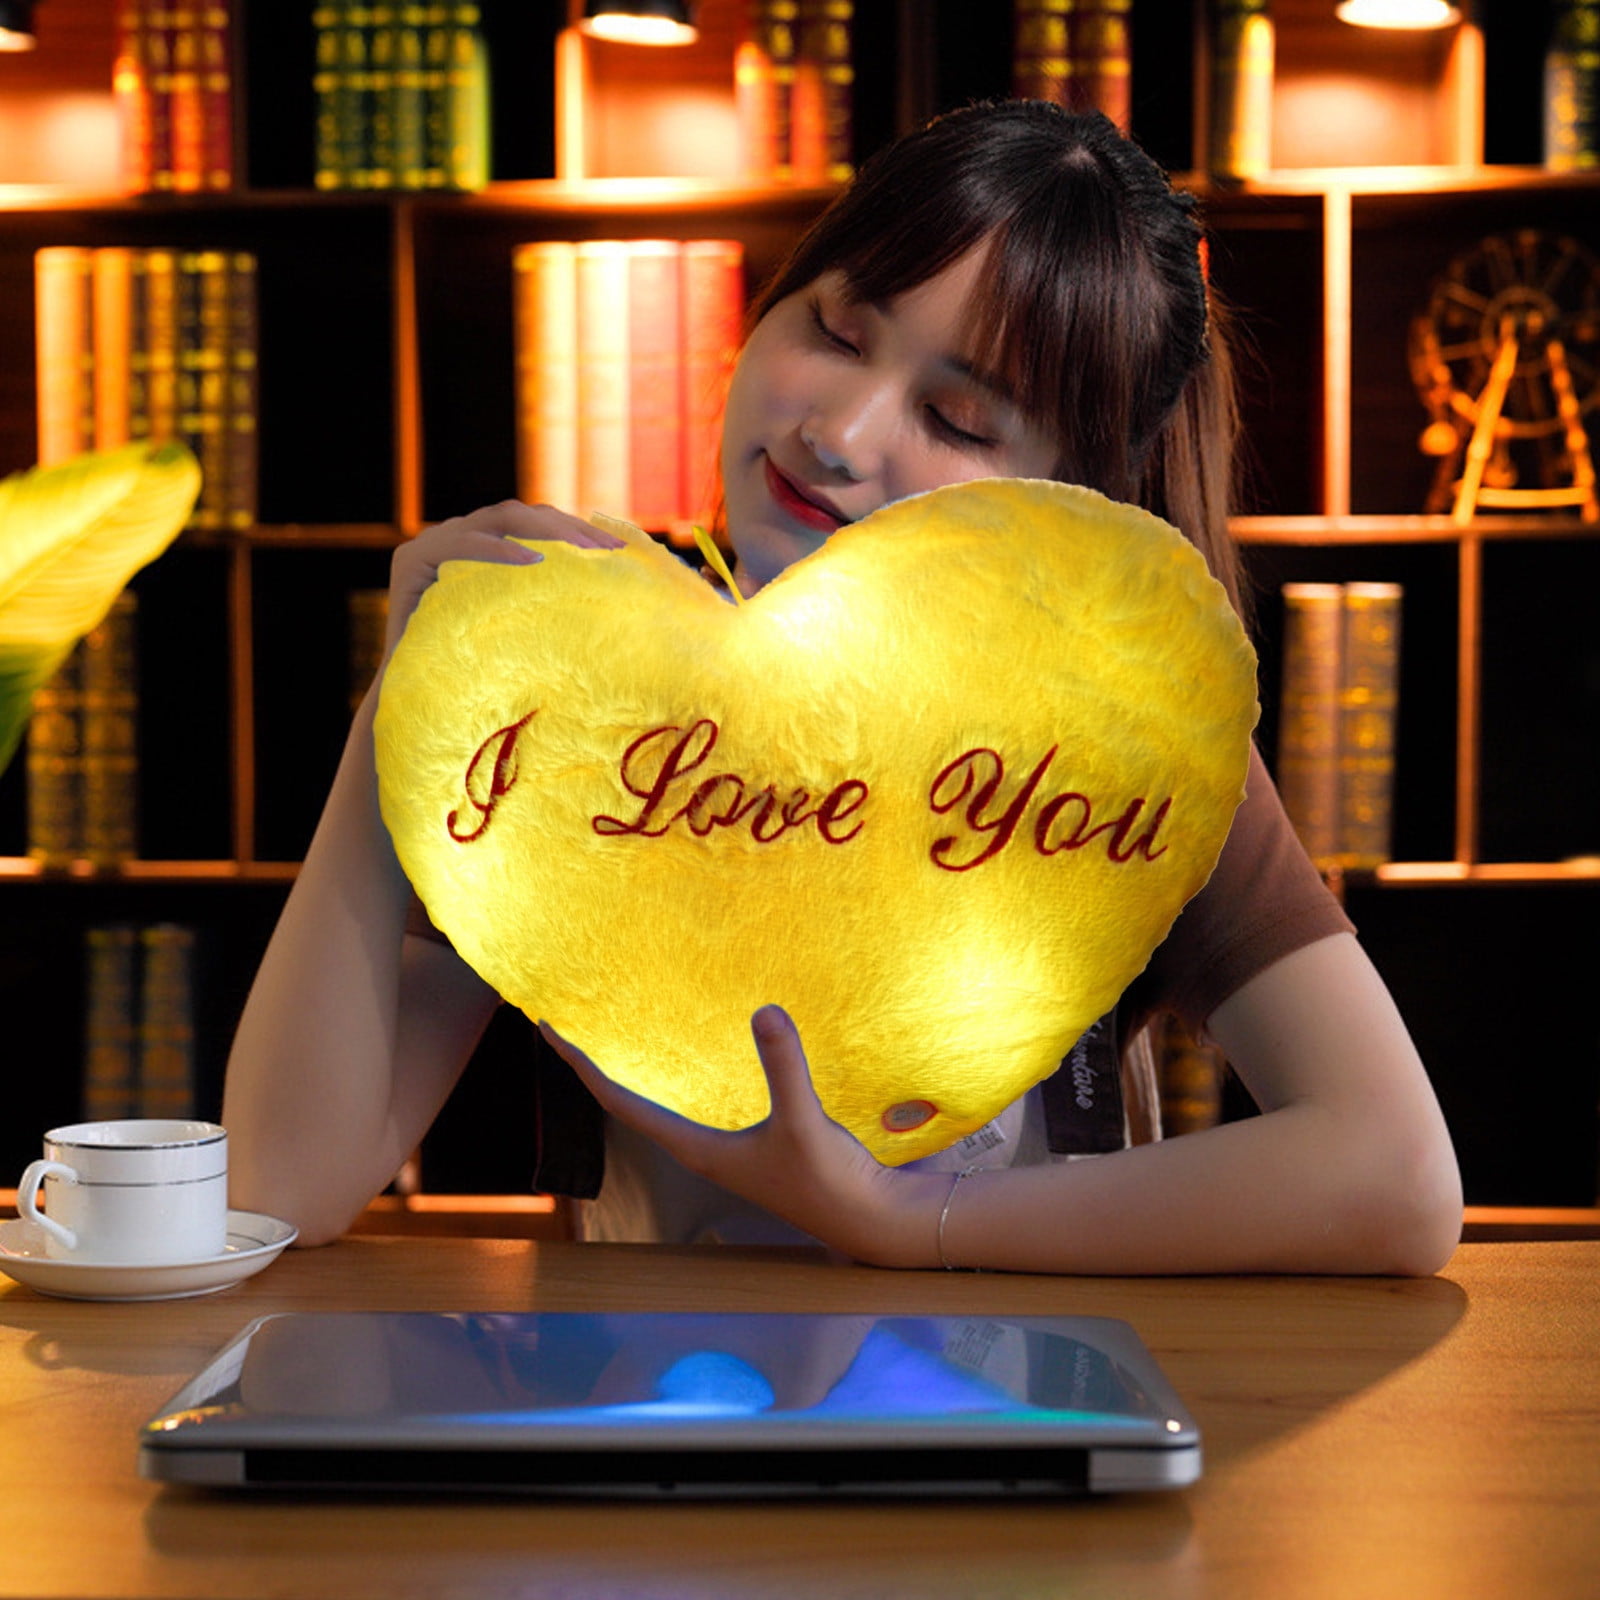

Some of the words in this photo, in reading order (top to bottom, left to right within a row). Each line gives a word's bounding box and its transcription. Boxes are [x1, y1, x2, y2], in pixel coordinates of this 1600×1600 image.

[447, 711, 536, 842] I
[592, 719, 869, 846] Love
[929, 744, 1172, 873] You
